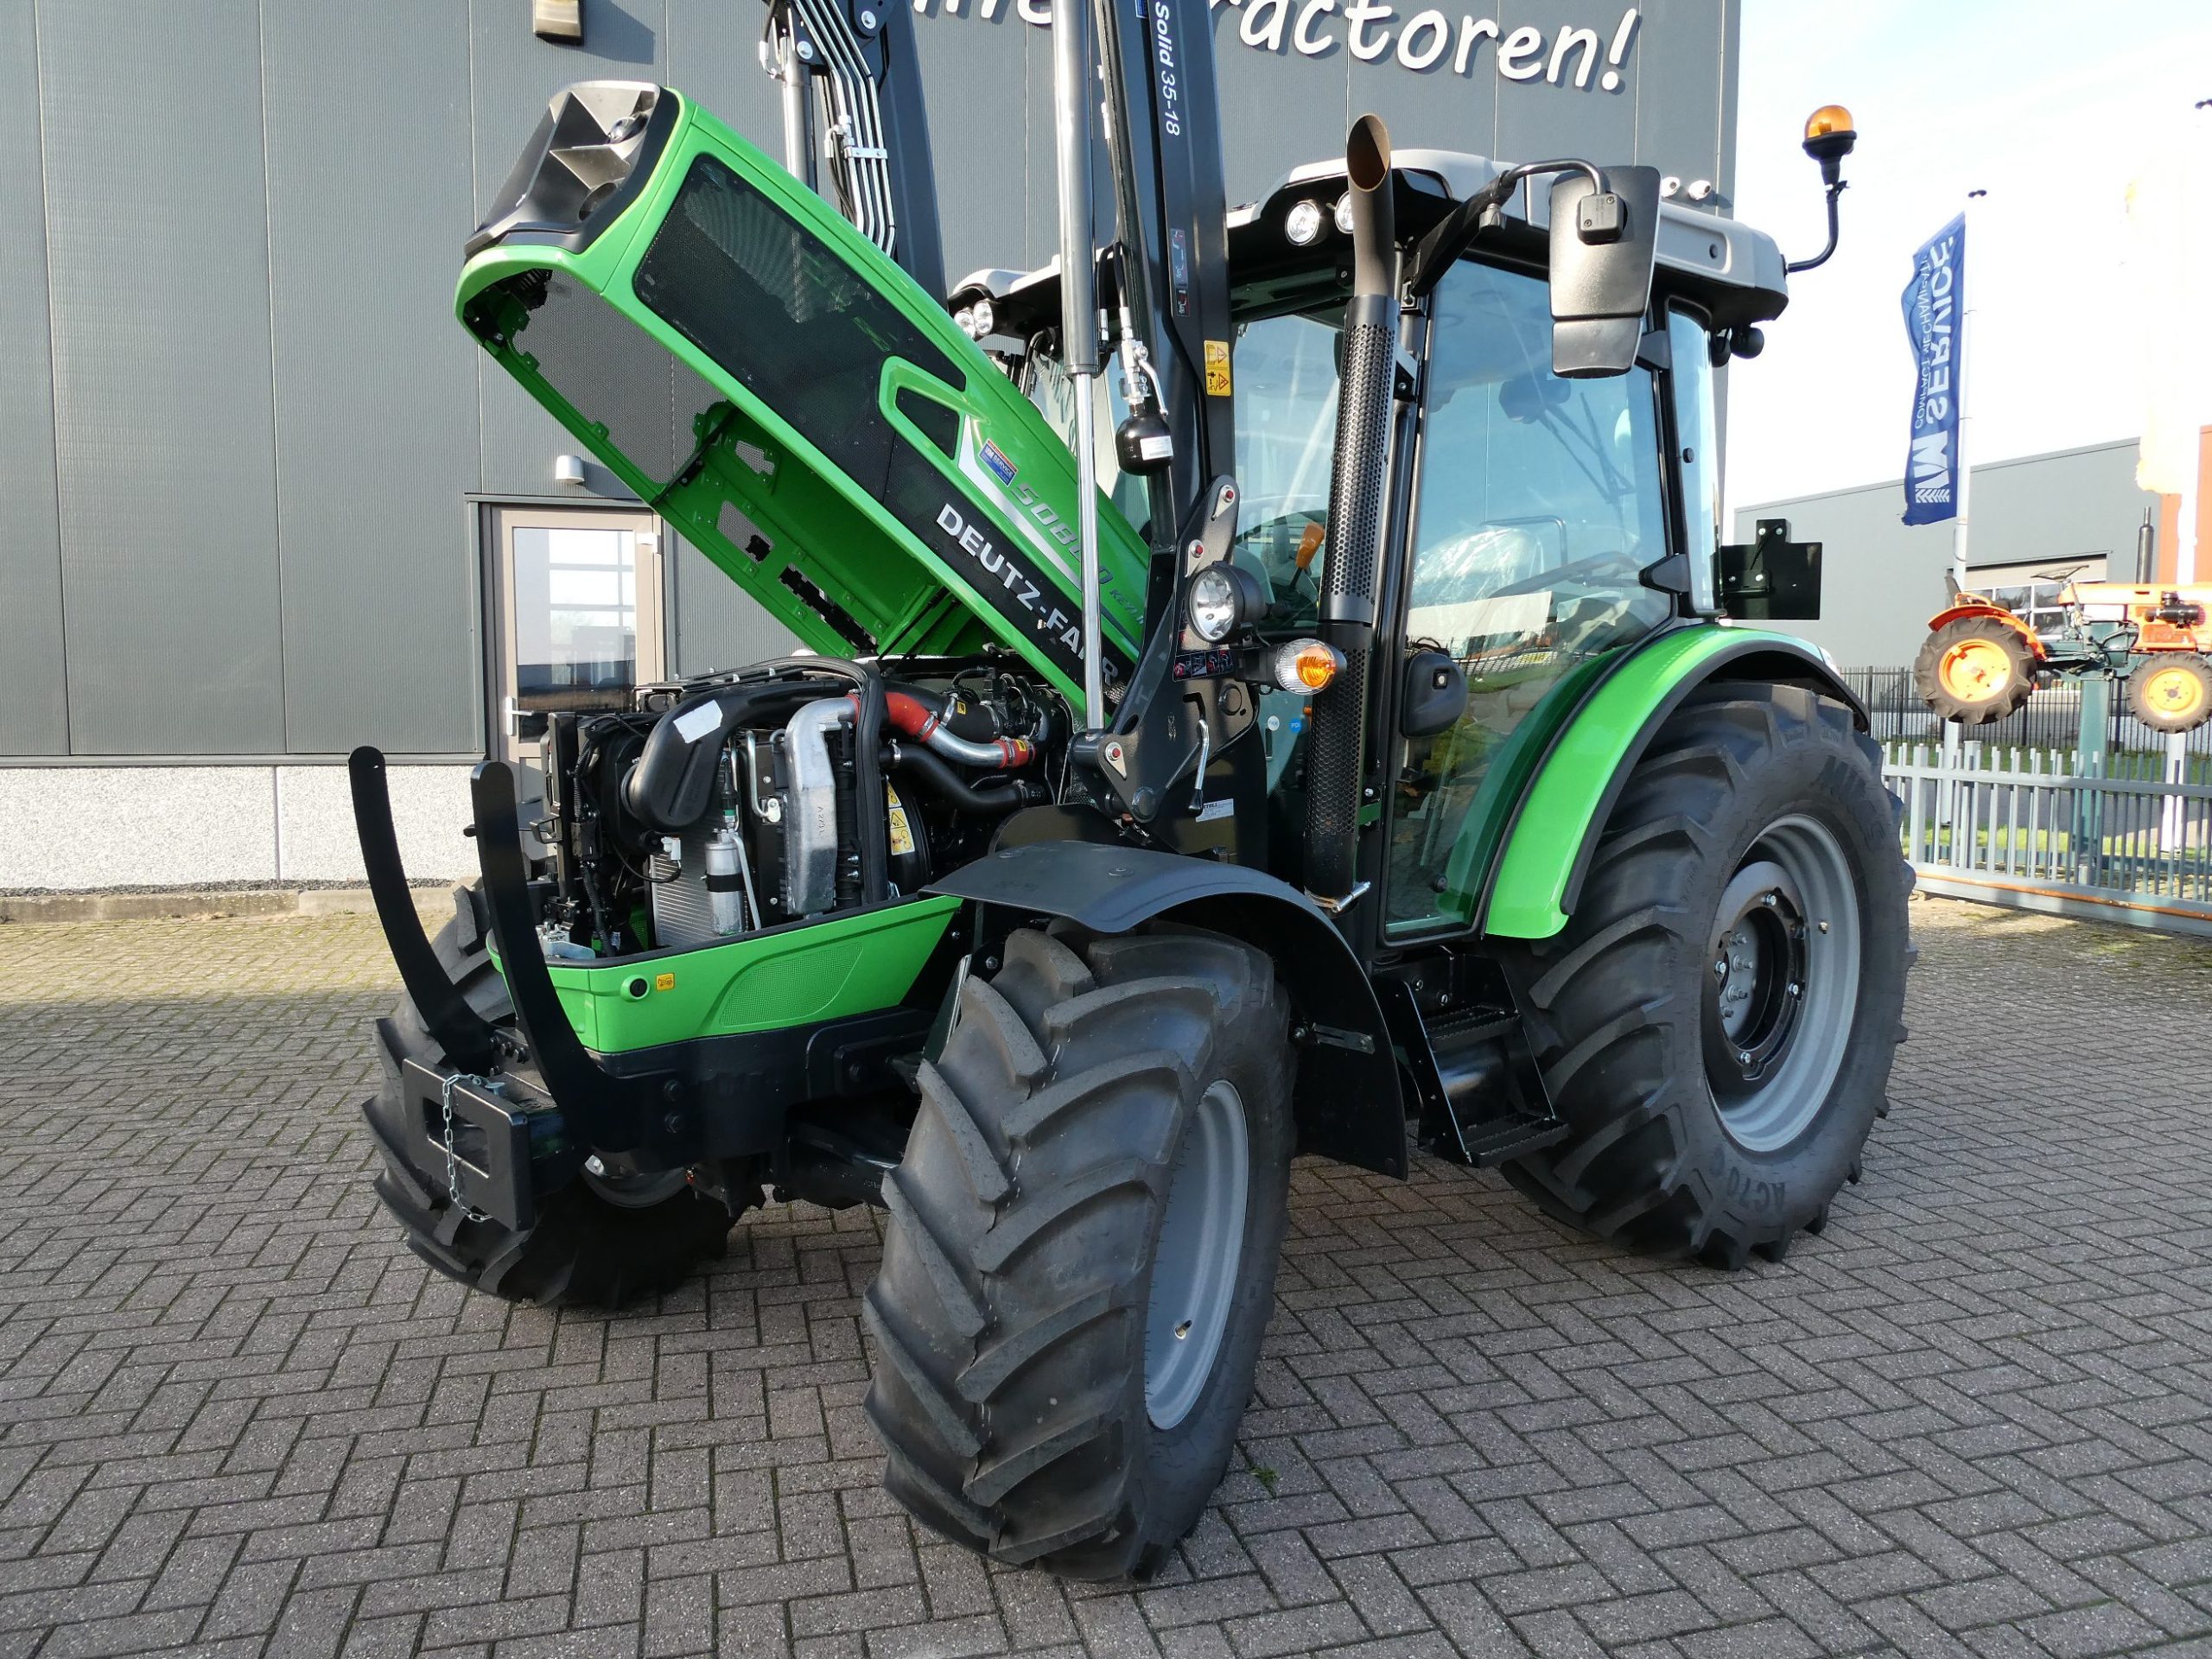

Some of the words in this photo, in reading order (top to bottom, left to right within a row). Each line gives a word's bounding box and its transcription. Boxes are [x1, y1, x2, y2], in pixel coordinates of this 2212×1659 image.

[1155, 2, 1174, 67] Solid
[1211, 0, 1637, 90] actoren!
[1161, 70, 1180, 136] 35-18
[993, 454, 1014, 480] SERVICE
[936, 503, 1119, 686] DEUTZ-FAR
